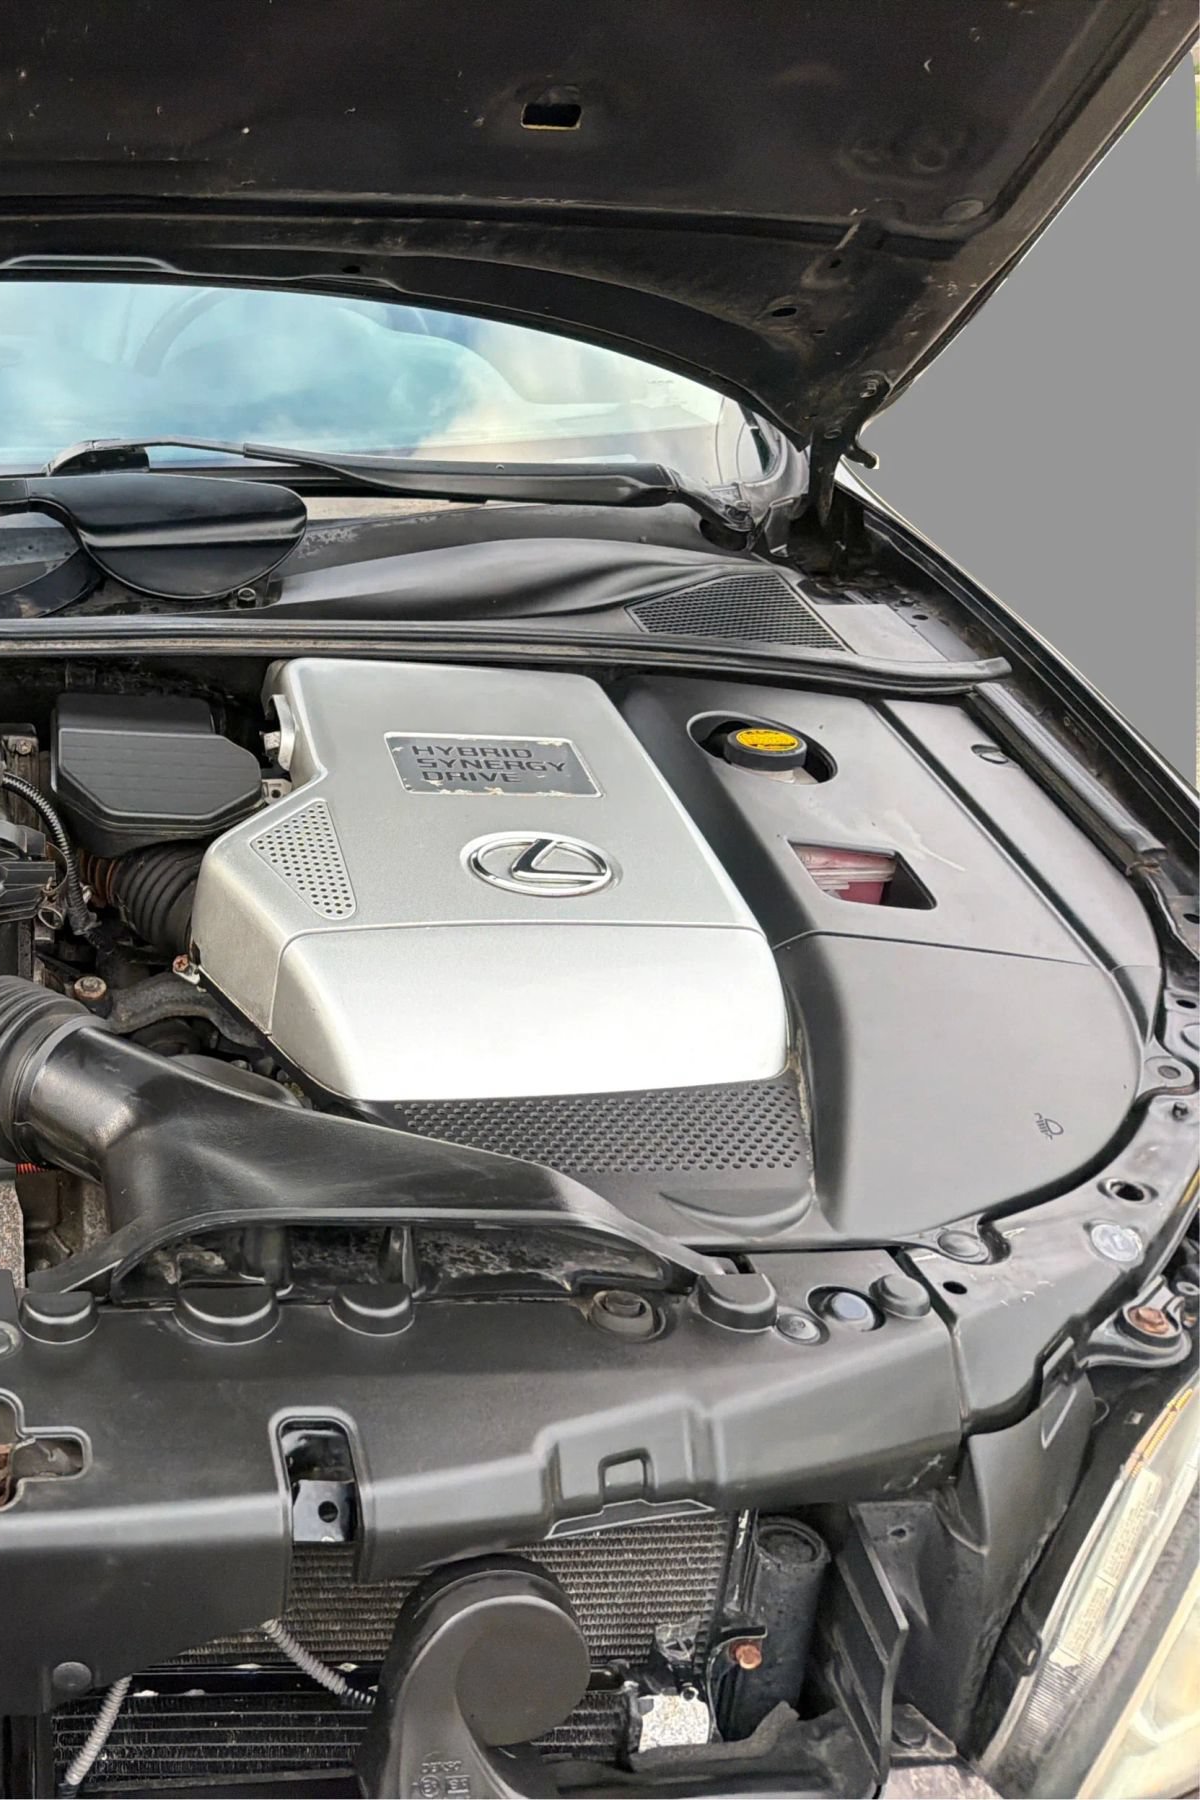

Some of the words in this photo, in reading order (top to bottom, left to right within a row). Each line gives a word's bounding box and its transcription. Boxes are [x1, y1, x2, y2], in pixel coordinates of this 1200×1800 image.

[412, 745, 533, 759] HYBRID
[416, 758, 566, 772] SYNERGY
[422, 771, 523, 783] DRIVE
